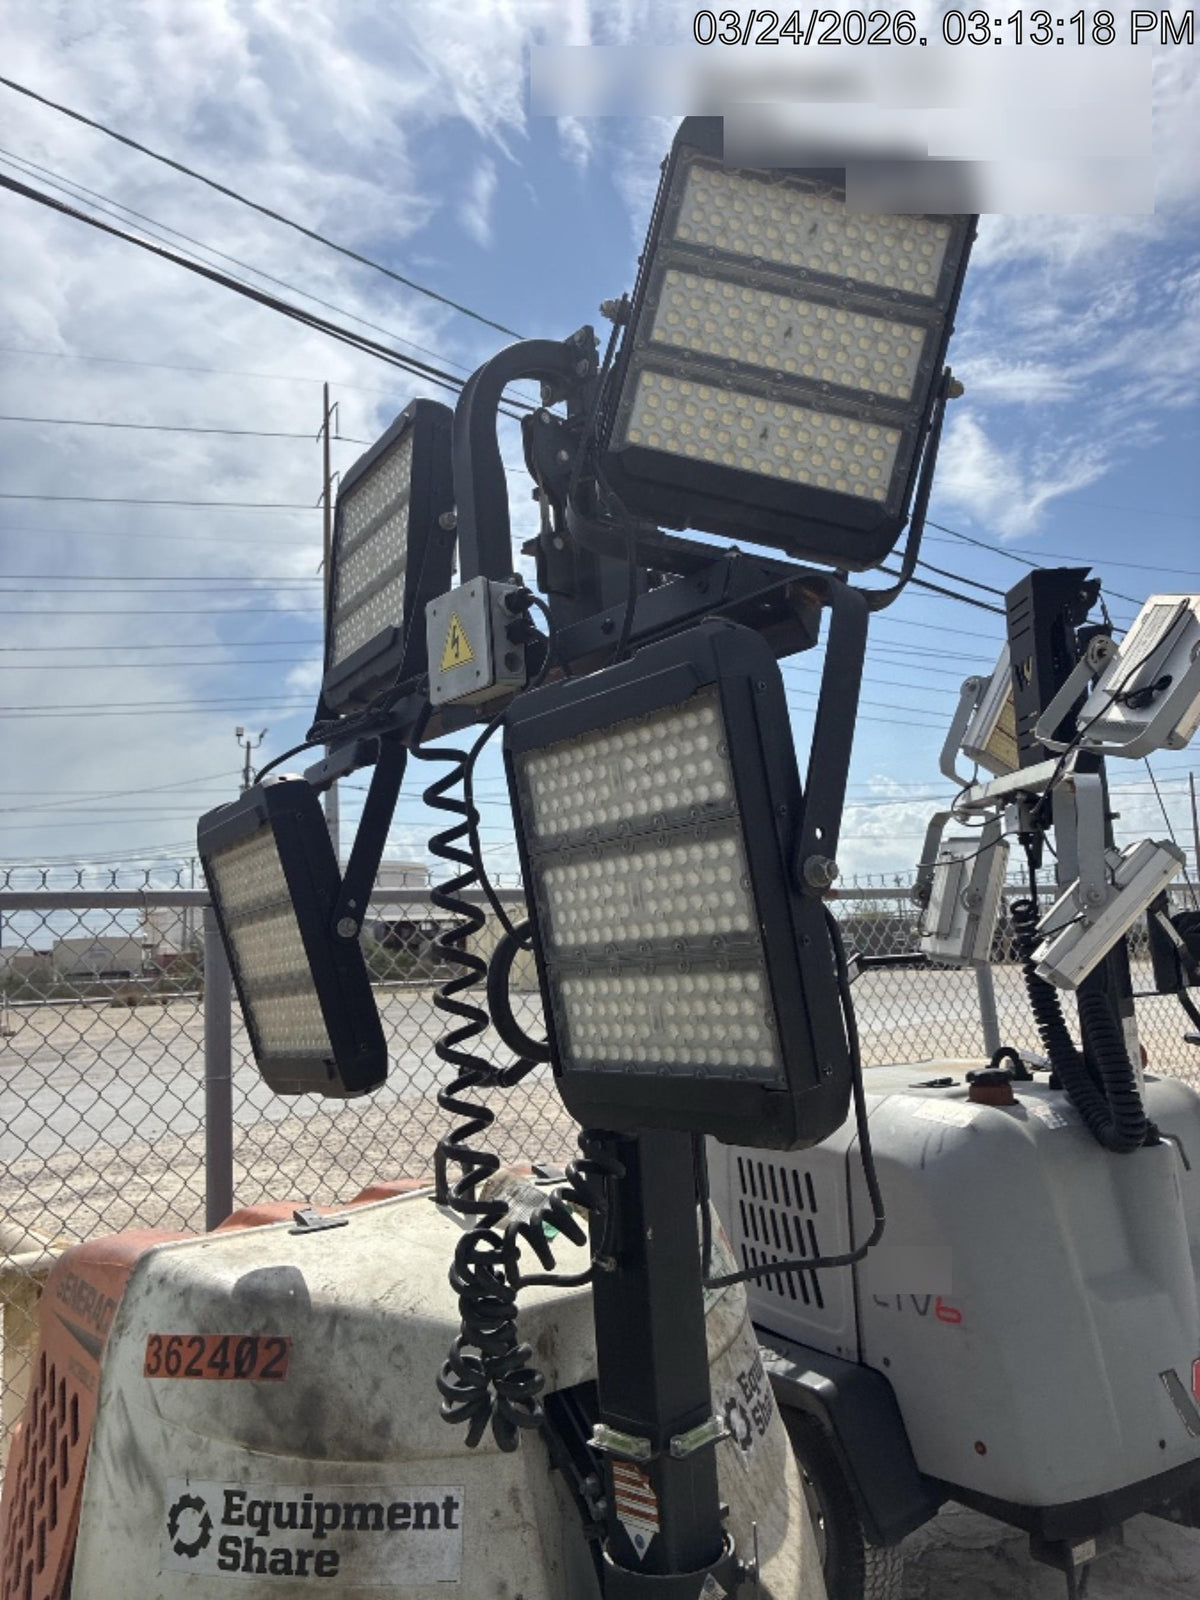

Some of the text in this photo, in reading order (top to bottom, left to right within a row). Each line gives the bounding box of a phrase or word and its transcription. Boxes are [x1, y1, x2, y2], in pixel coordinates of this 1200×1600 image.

[146, 1334, 288, 1379] 362402
[220, 1489, 459, 1539] Equipment
[217, 1534, 341, 1578] Share
